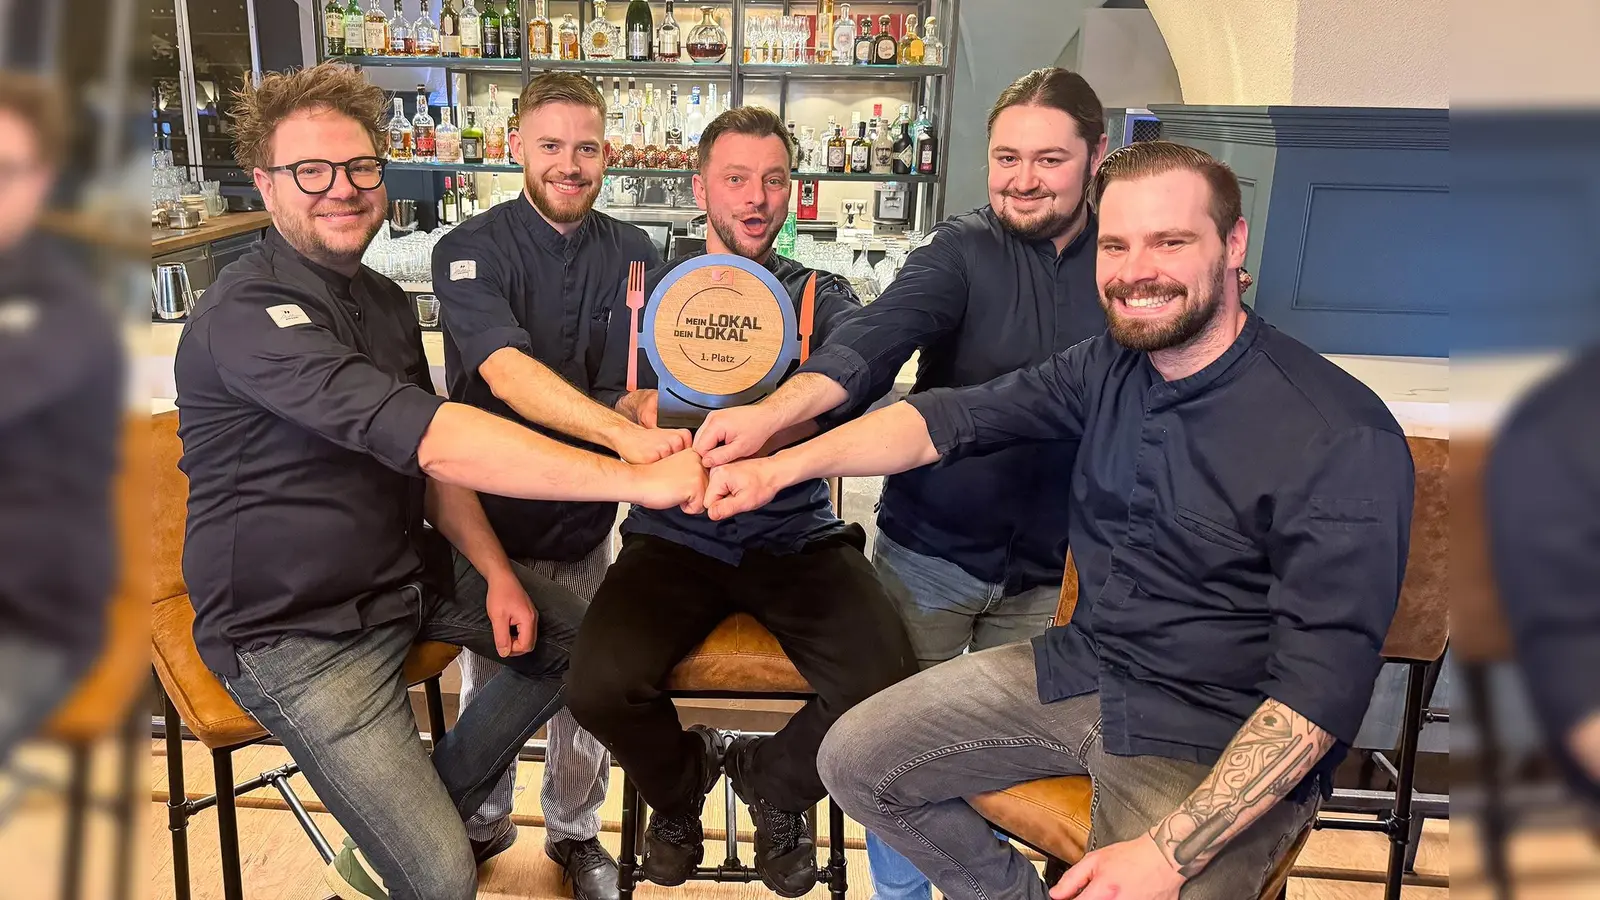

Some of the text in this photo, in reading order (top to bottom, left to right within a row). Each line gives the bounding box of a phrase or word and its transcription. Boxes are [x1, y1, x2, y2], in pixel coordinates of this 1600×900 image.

[685, 313, 762, 330] MEIN LOKAL
[673, 325, 748, 342] DEIN LOKAL
[700, 352, 735, 363] 1. Platz
